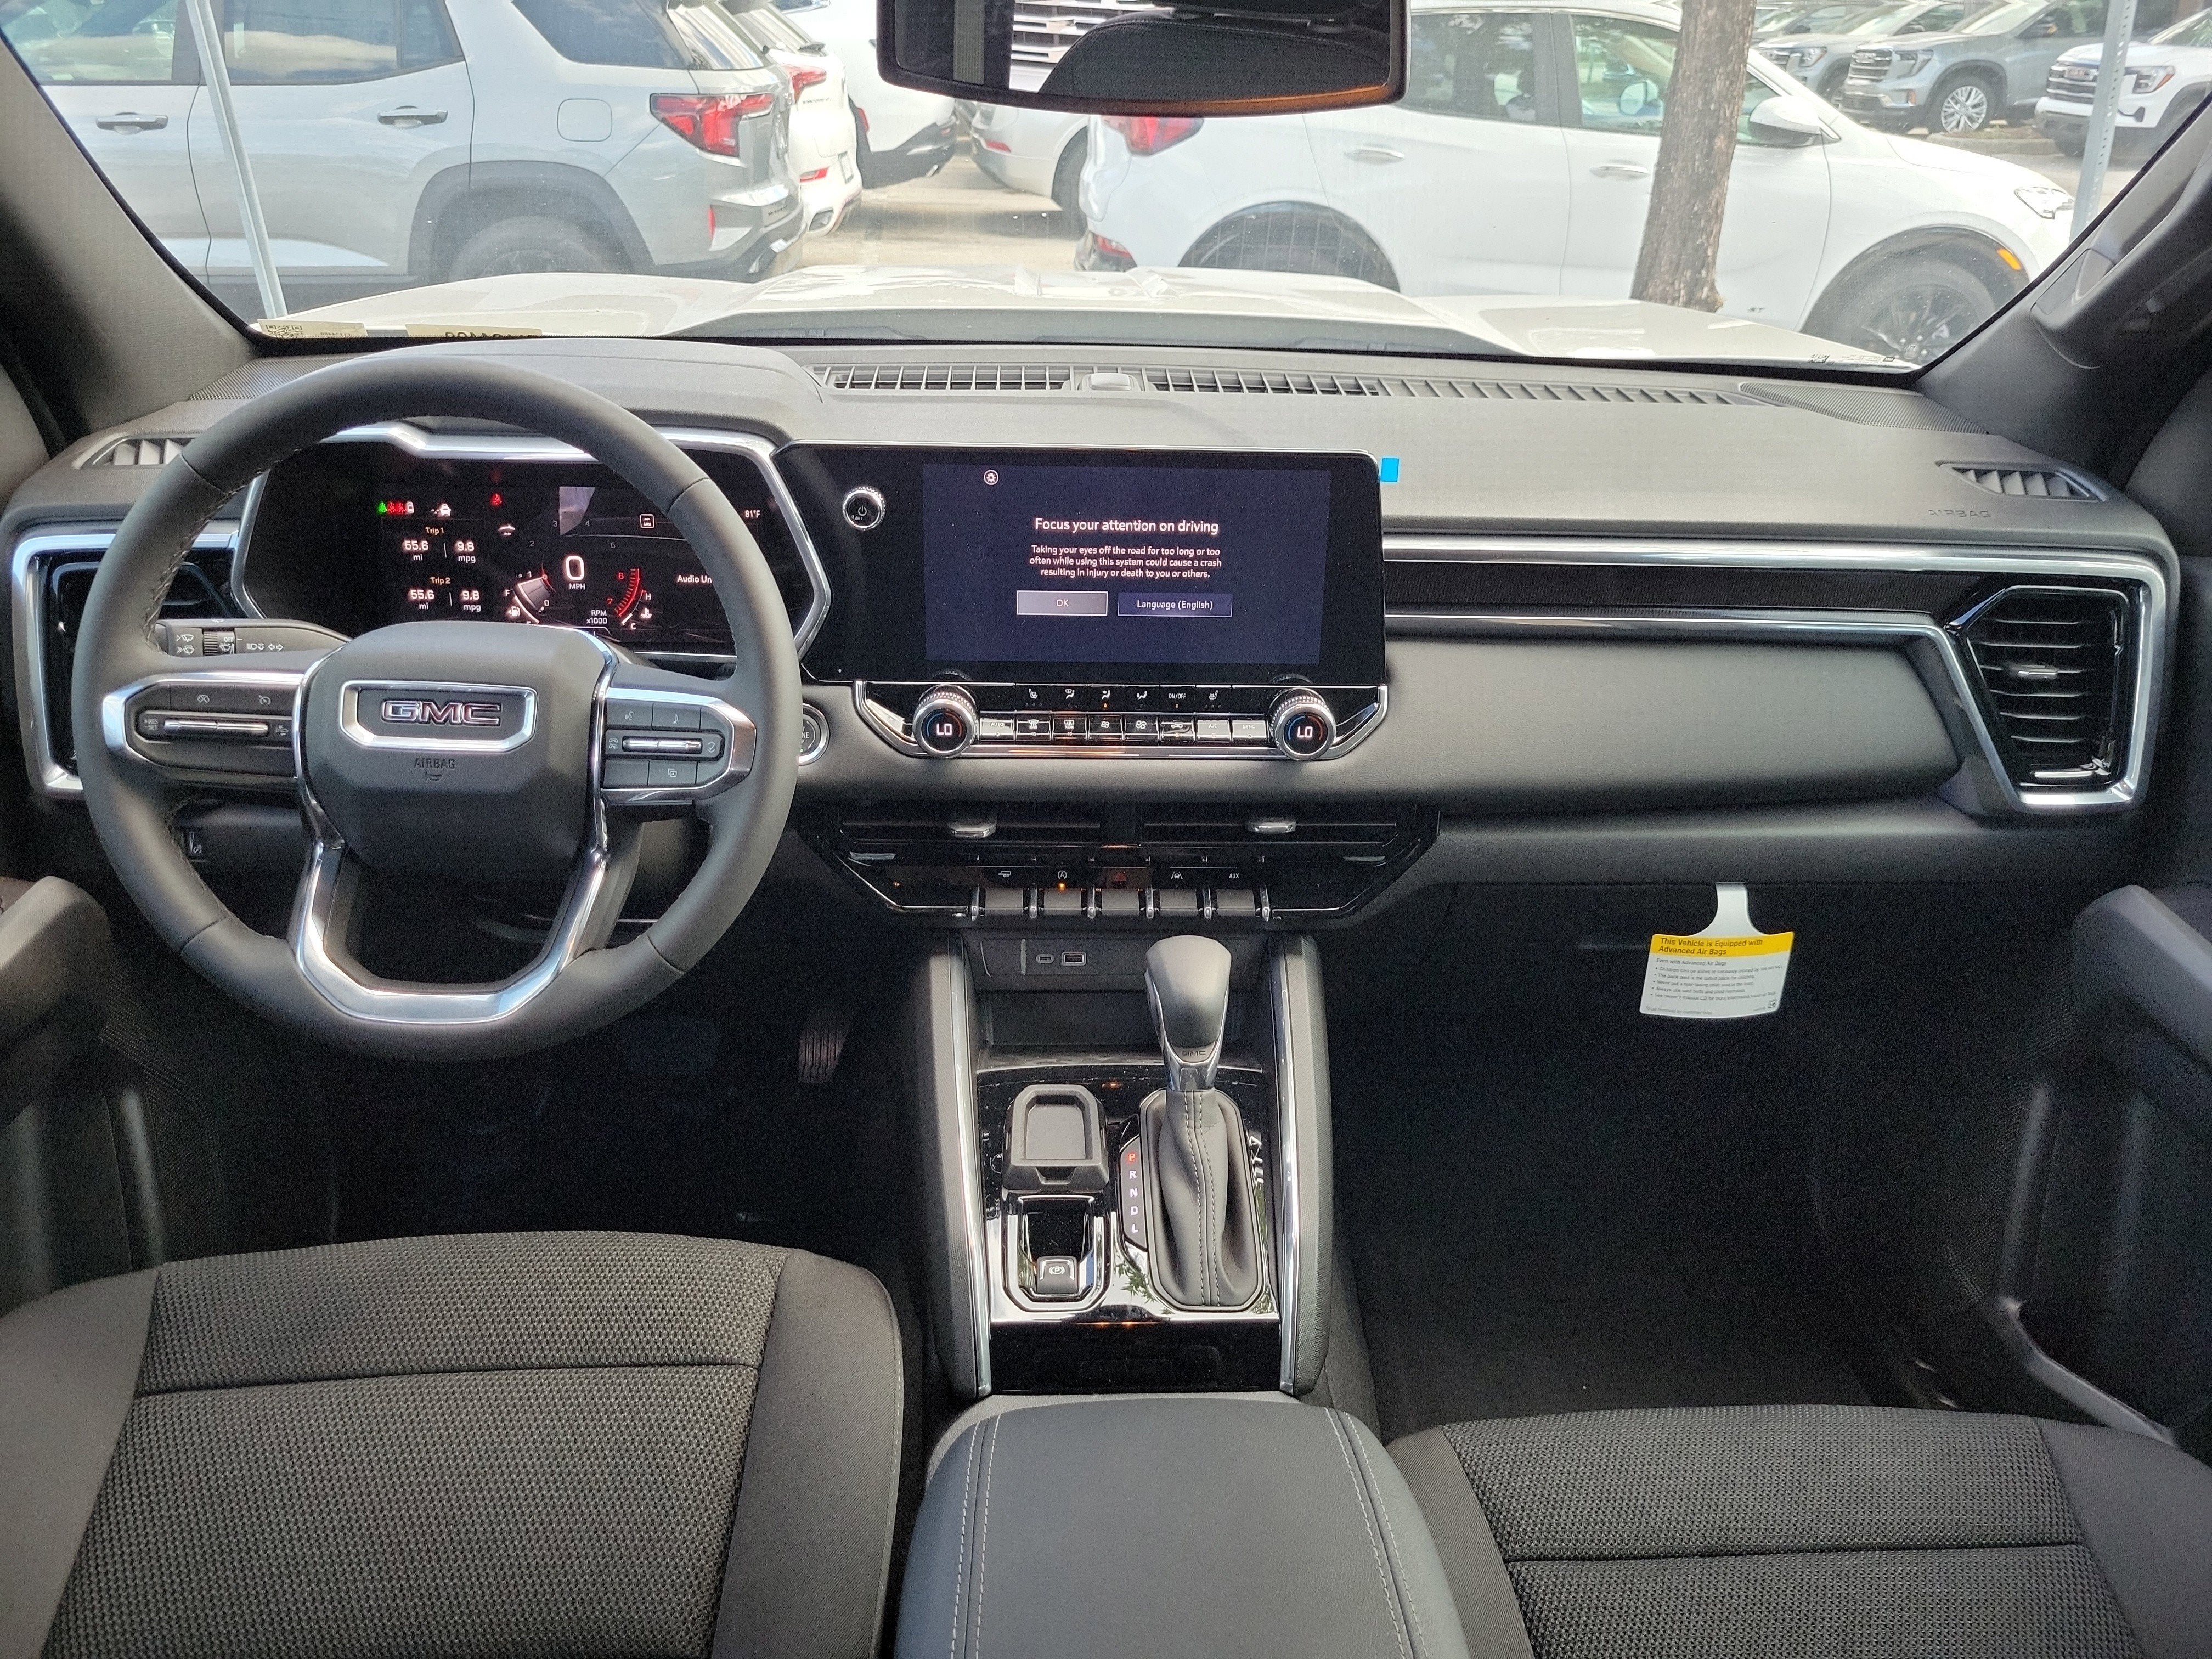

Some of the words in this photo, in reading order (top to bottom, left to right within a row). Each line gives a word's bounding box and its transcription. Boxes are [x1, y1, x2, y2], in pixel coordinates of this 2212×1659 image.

[1928, 509, 1991, 518] AIRBAG
[425, 527, 439, 535] Trip
[1035, 517, 1070, 530] Focus
[1073, 521, 1099, 533] your
[1102, 520, 1156, 531] attention
[1159, 522, 1175, 532] on
[1178, 520, 1218, 535] driving
[404, 540, 429, 551] 55.6
[457, 541, 475, 551] 9.8
[1031, 545, 1058, 555] Taking
[1079, 548, 1097, 556] eyes
[1099, 545, 1111, 554] off
[1113, 546, 1126, 554] the
[1127, 546, 1146, 555] road
[1147, 546, 1160, 555] for
[1161, 547, 1175, 555] too
[1177, 546, 1194, 557] long
[1206, 548, 1221, 556] too
[458, 555, 476, 563] mpg
[1029, 556, 1051, 565] often
[1053, 556, 1074, 565] while
[1076, 557, 1097, 567] using
[1099, 557, 1114, 566] this
[1115, 558, 1144, 567] system
[1146, 557, 1167, 566] could
[1200, 558, 1222, 567] crash
[565, 555, 585, 580] 0
[1041, 567, 1075, 578] resulting
[1086, 568, 1109, 578] injury
[1121, 568, 1144, 577] death
[1146, 569, 1154, 577] to
[1155, 571, 1170, 579] you
[1182, 569, 1210, 578] others.
[430, 577, 444, 585] Trip
[410, 589, 435, 599] 55.6
[462, 590, 480, 600] 9.8
[464, 603, 481, 612] mpg
[1056, 599, 1069, 607] OK
[1137, 600, 1176, 610] Language
[1178, 600, 1213, 610] (English)
[382, 699, 501, 726] GMC
[936, 723, 952, 736] LO
[1297, 726, 1313, 738] LO
[414, 758, 455, 769] AIRBAG
[1714, 940, 1746, 948] Equipped
[1658, 945, 1695, 954] Advanced
[1128, 1153, 1136, 1162] P
[1129, 1170, 1137, 1179] R
[1130, 1188, 1138, 1197] N
[1131, 1206, 1139, 1215] D
[1132, 1224, 1139, 1233] L
